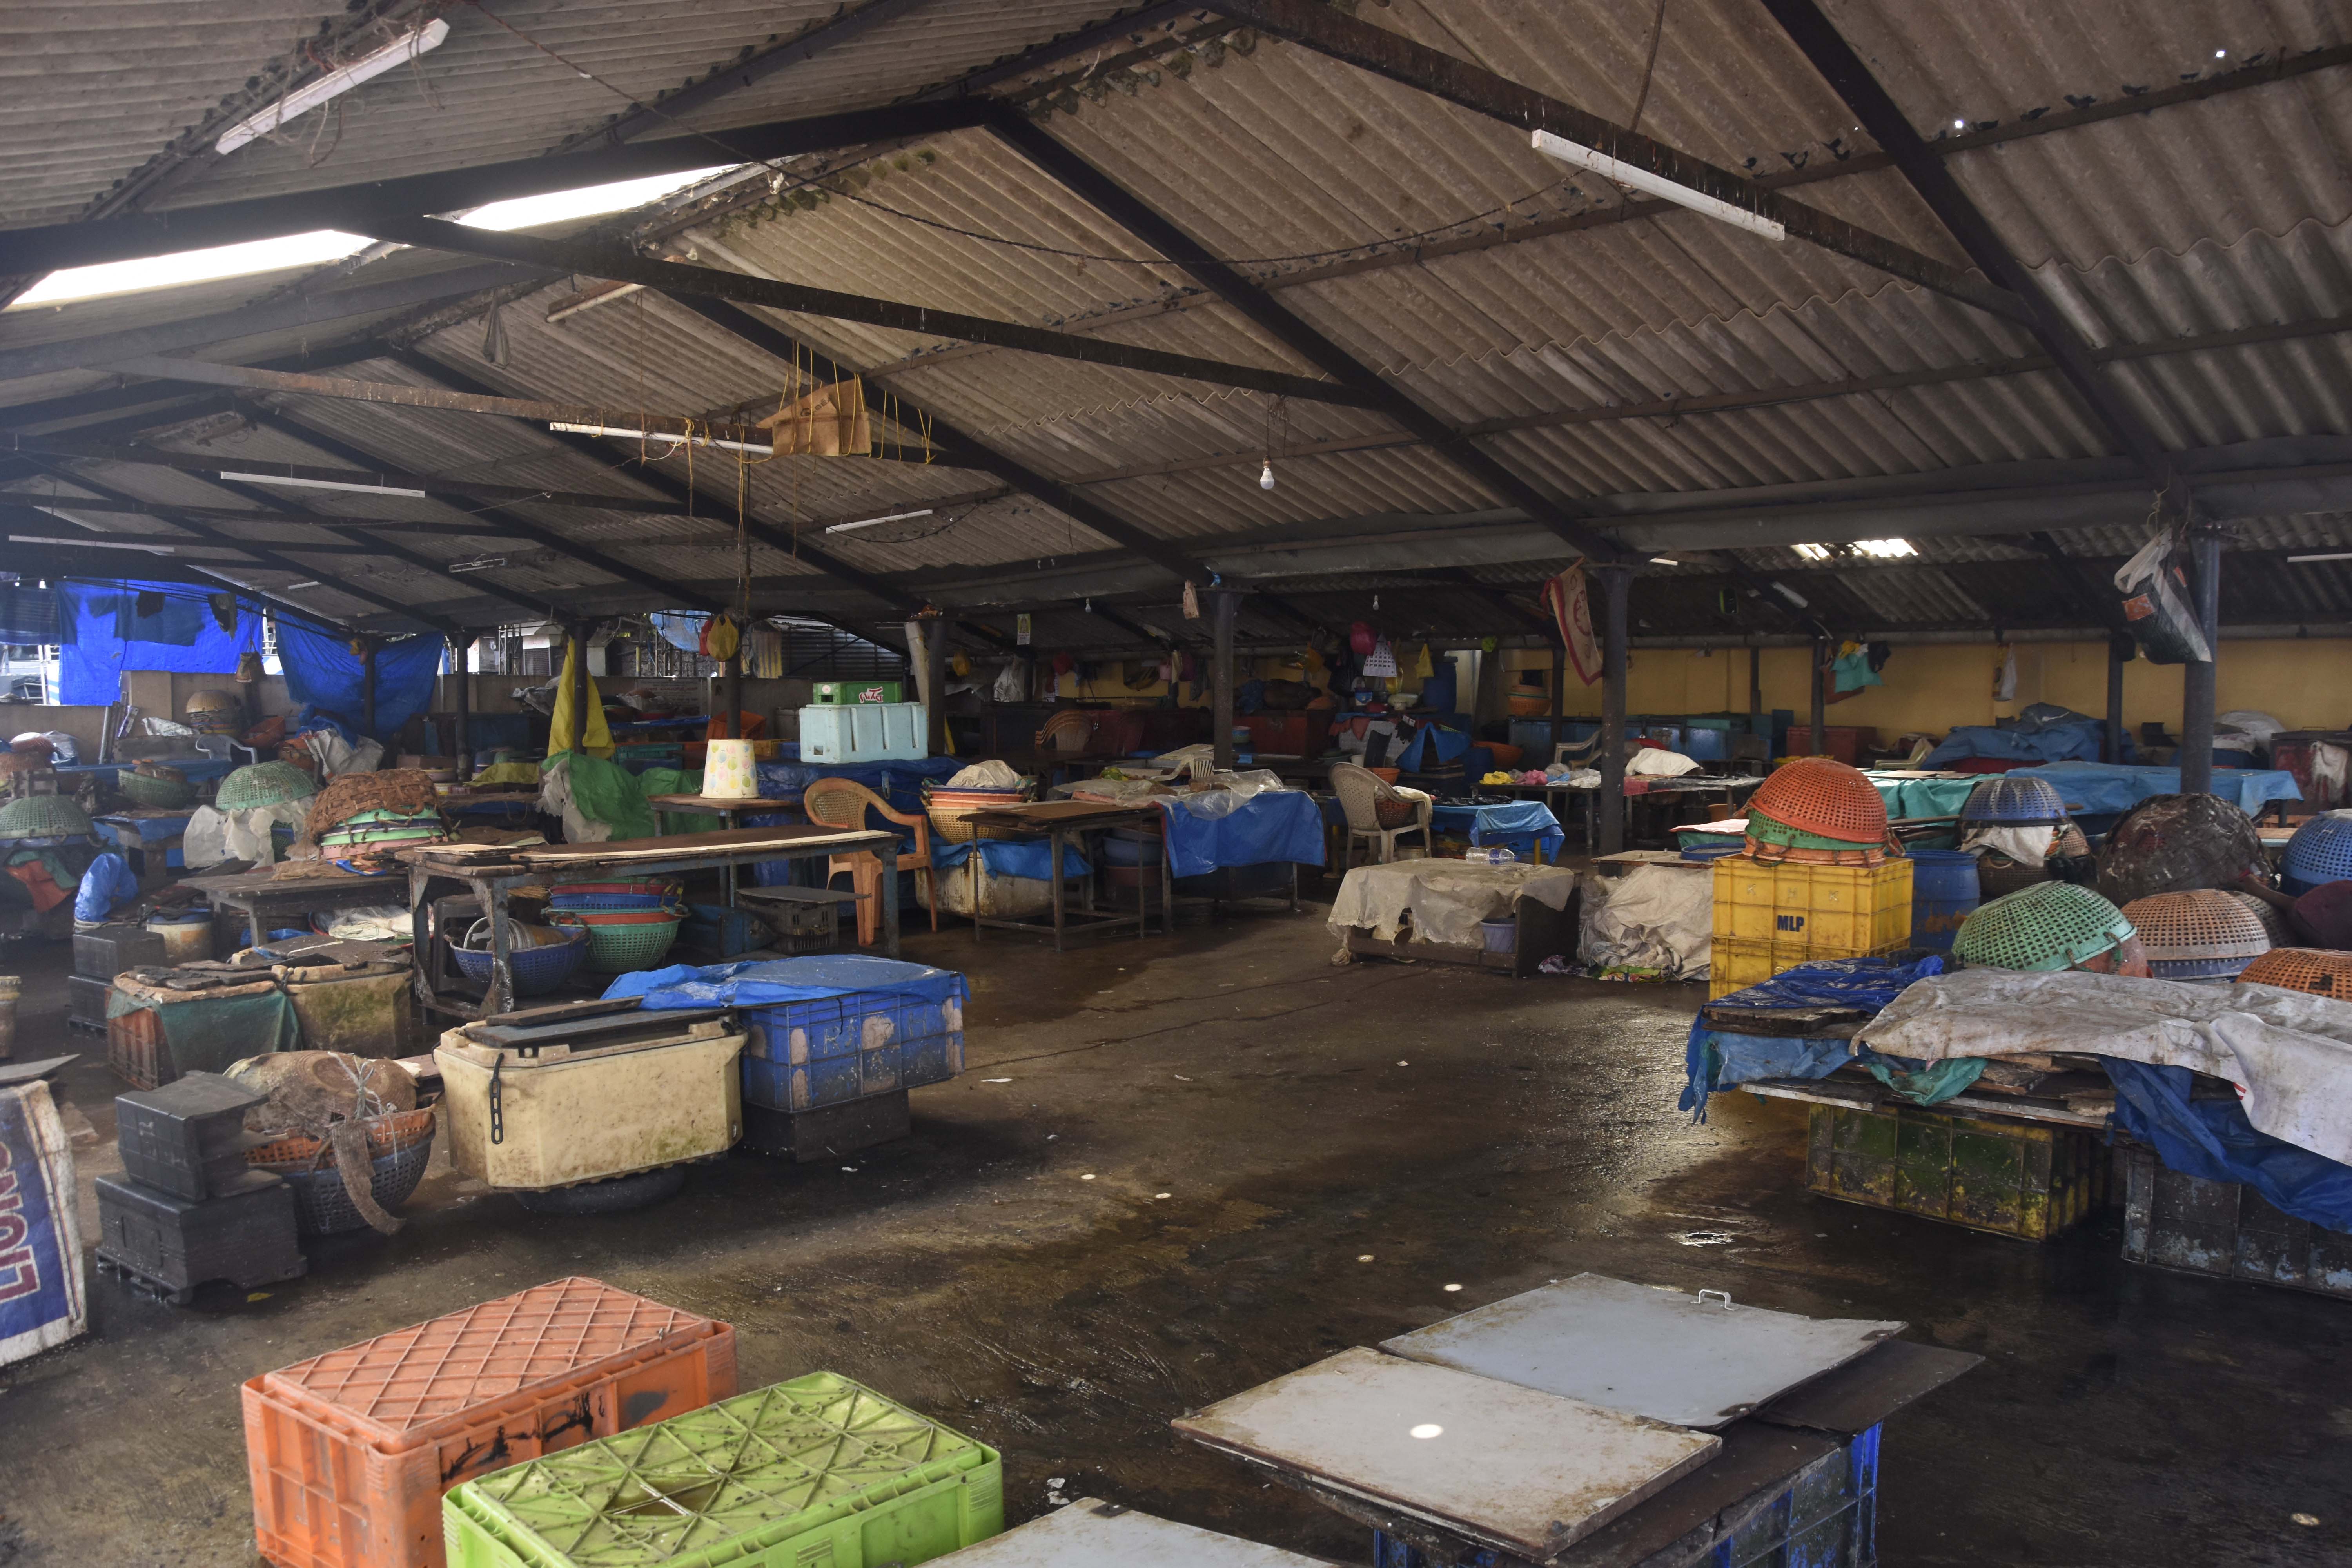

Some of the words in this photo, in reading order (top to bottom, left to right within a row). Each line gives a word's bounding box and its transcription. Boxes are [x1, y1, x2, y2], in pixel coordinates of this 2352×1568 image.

[1829, 890, 1839, 902] K
[1777, 915, 1804, 932] MLP
[909, 1007, 927, 1037] H
